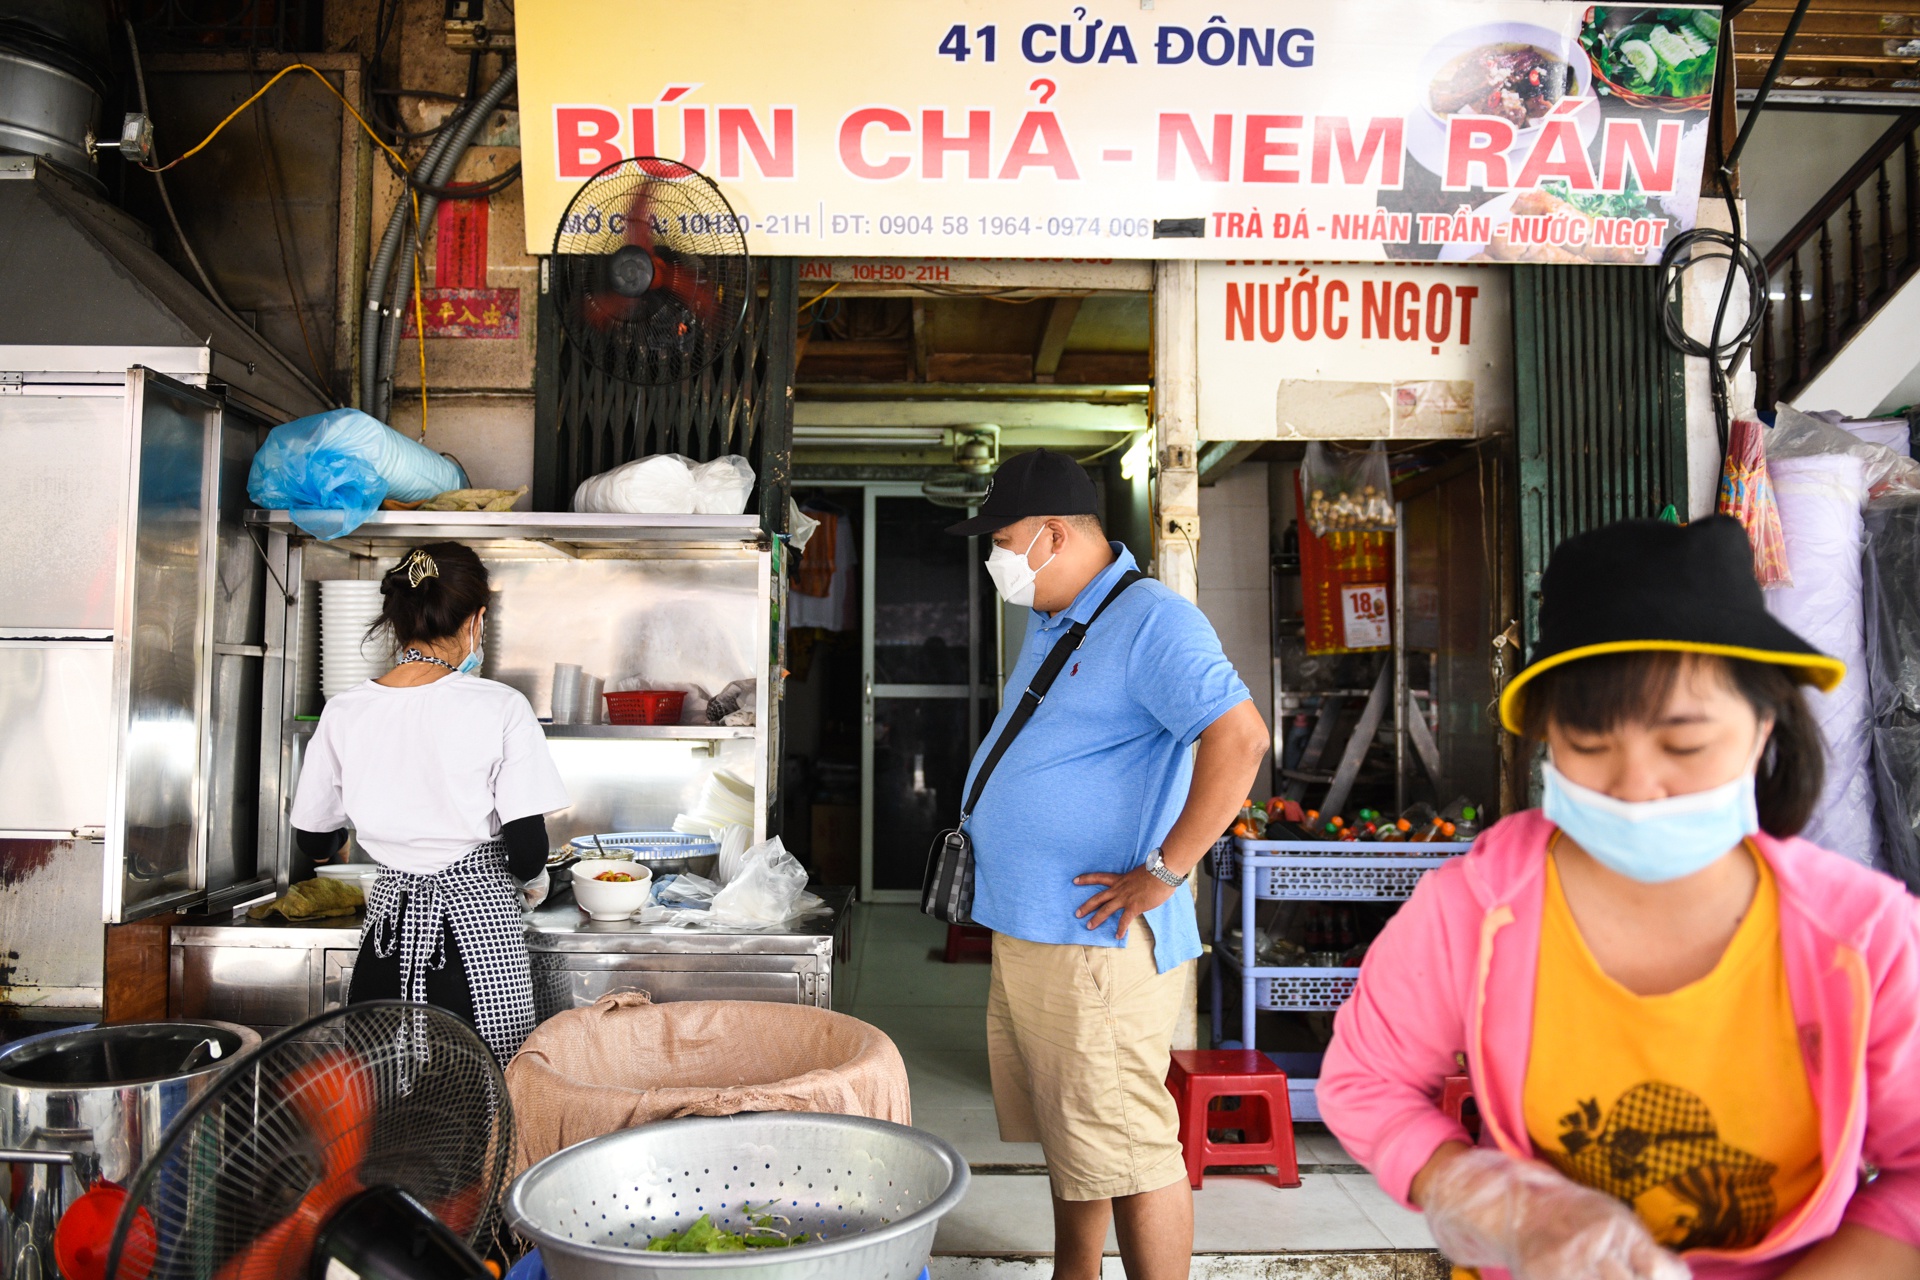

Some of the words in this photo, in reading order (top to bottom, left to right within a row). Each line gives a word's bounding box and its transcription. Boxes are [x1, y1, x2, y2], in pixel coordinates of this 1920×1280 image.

[939, 25, 995, 62] 41
[1021, 6, 1137, 64] CỬA
[1155, 15, 1315, 68] ĐÔNG
[555, 86, 794, 180] BÚN
[838, 78, 1080, 181] CHẢ
[1156, 112, 1405, 186] NEM
[1444, 98, 1684, 192] RÁN
[562, 205, 602, 234] MỞ
[608, 213, 669, 236] CA:
[832, 214, 870, 235] ĐT:
[879, 214, 934, 236] 0904
[941, 215, 969, 236] 58
[1109, 216, 1150, 238] 006
[1212, 206, 1263, 239] TRÀ
[1272, 207, 1310, 240] ĐÁ
[1331, 210, 1410, 241] NHÂN
[1418, 207, 1491, 243] TRẦN
[1510, 212, 1586, 244] NƯỚC
[1594, 218, 1668, 253] NGỌT
[1224, 267, 1350, 343] NƯỚC
[1361, 280, 1479, 355] NGỌT
[1350, 592, 1373, 614] 18
